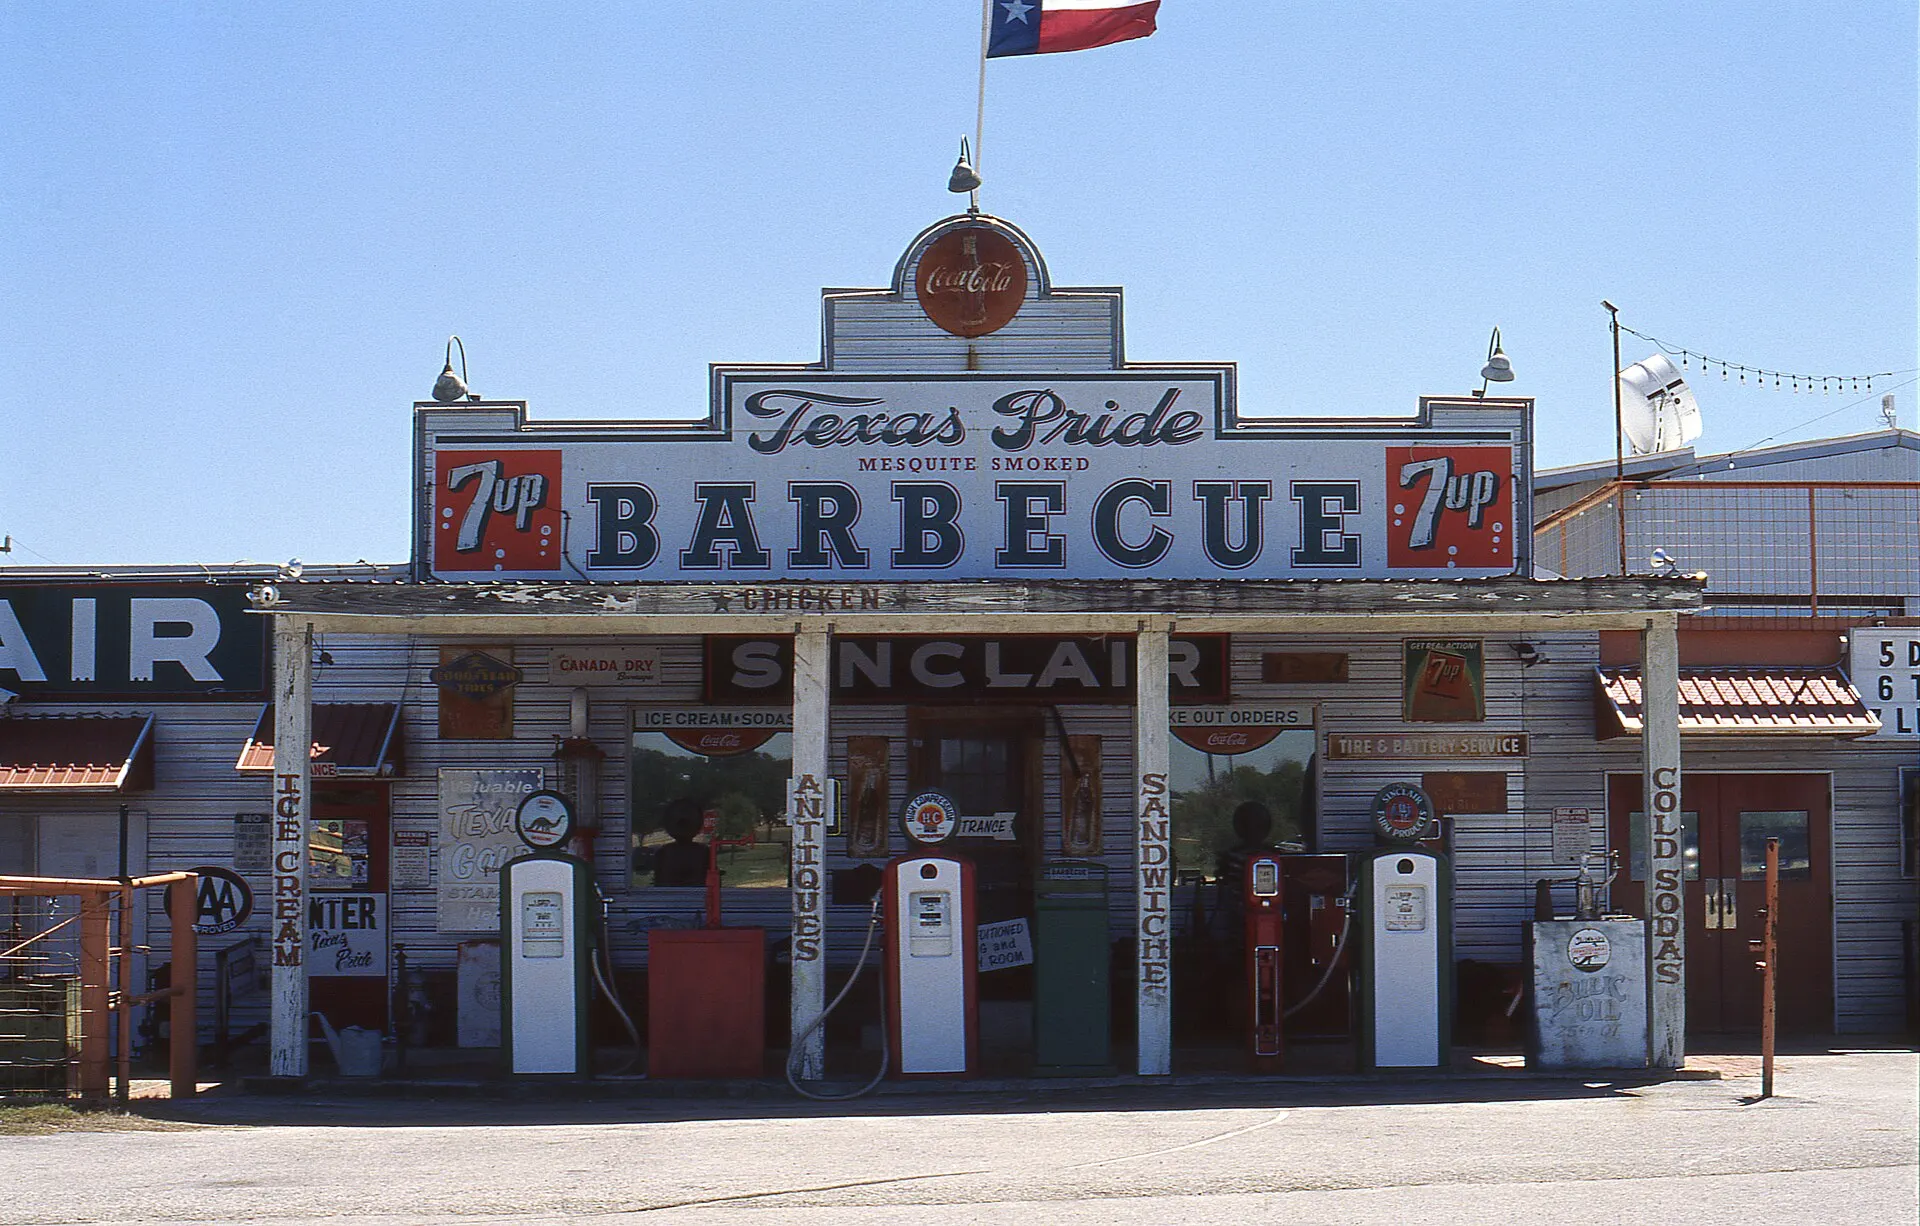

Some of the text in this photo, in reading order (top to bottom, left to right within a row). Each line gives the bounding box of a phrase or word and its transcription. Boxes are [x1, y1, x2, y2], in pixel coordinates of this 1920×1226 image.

[745, 388, 1204, 455] Texas Pride
[858, 457, 1090, 473] MESQUITE SMOKED
[586, 478, 1361, 571] BARBECUE
[744, 588, 880, 610] CHICKEN
[560, 660, 654, 672] CANADA DRY
[731, 641, 1200, 689] SNCLAIR
[1879, 641, 1895, 667] 5
[1878, 675, 1893, 700] 6
[645, 712, 672, 725] ICE
[1193, 711, 1224, 723] OUT
[1231, 711, 1299, 724] ORDERS
[1338, 738, 1520, 754] TIRE & BATTERY SERVICE
[1382, 788, 1423, 804] SINCLAIR
[273, 774, 301, 967] ICE CREAM
[795, 774, 824, 962] ANTIQUES
[1652, 767, 1683, 985] COLD SODAS
